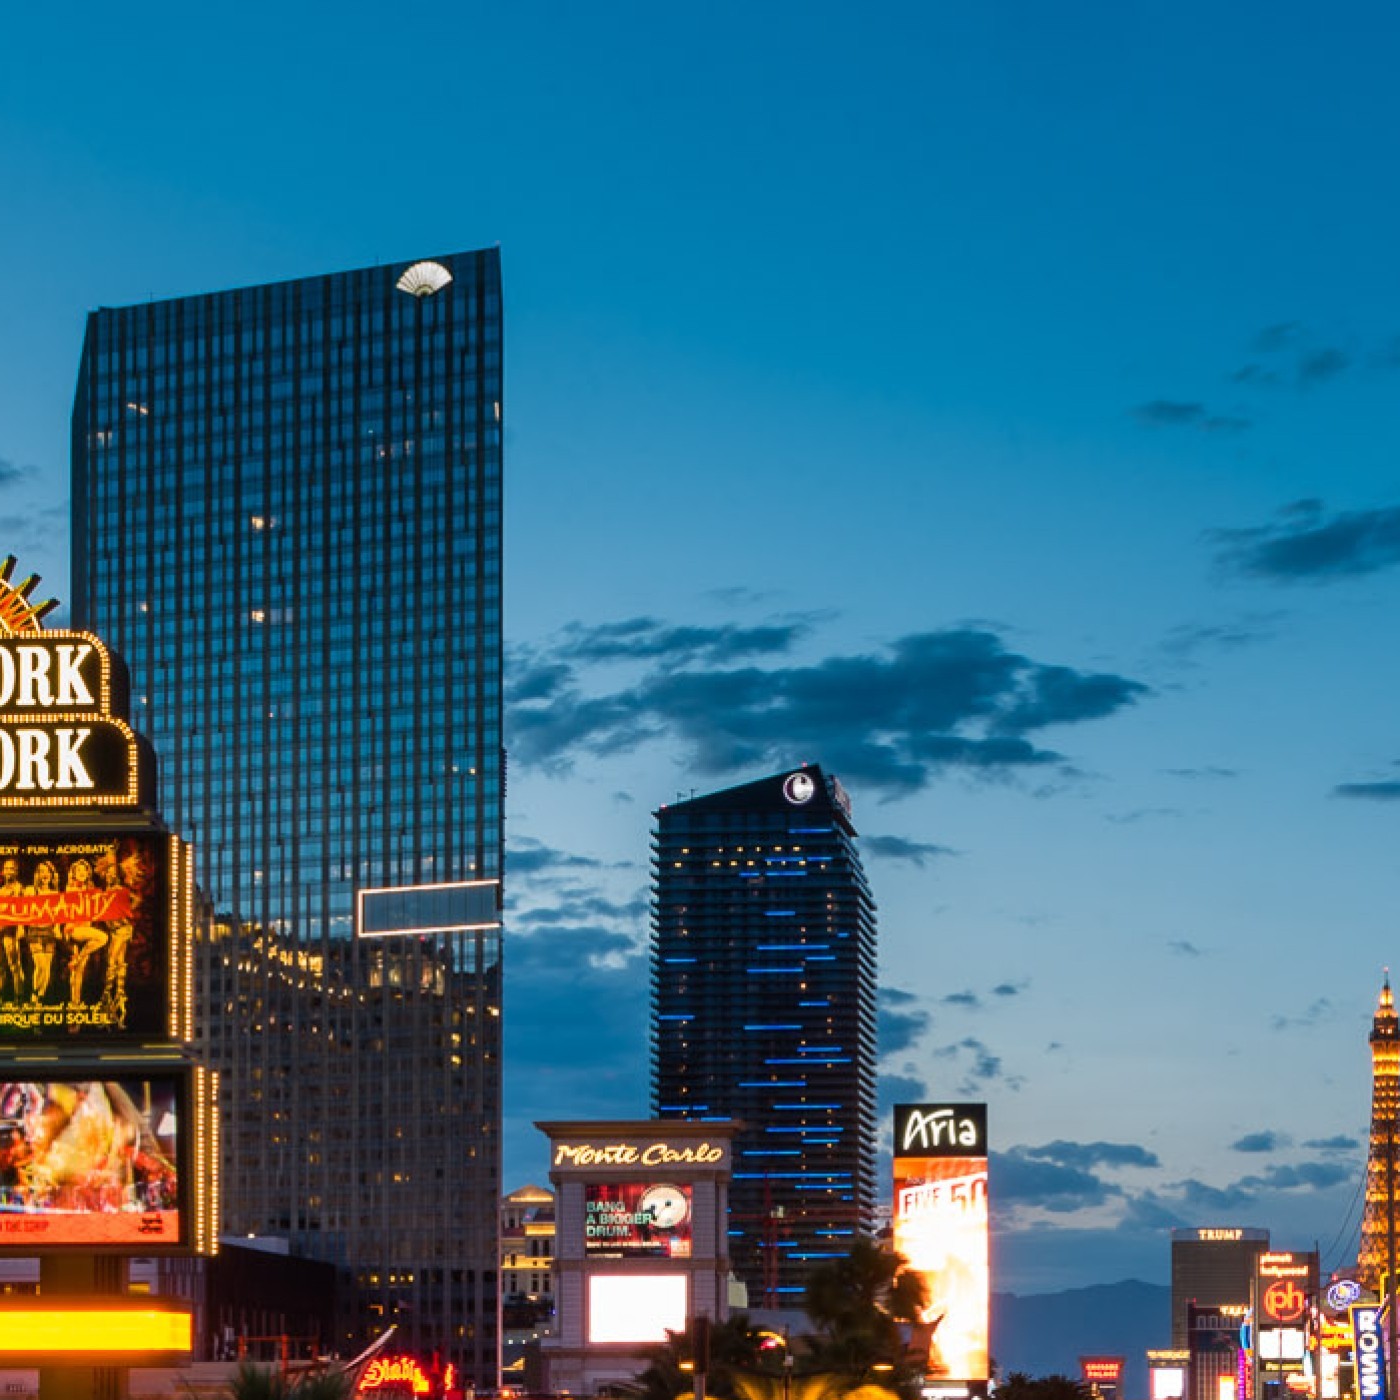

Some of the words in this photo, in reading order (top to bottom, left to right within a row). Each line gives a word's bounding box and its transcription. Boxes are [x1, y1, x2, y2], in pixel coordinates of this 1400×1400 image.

[28, 845, 49, 855] FUN
[44, 1013, 63, 1025] DU
[67, 1013, 112, 1025] SOLEIL
[903, 1109, 976, 1150] Aria
[554, 1144, 640, 1166] Monte
[642, 1143, 723, 1166] Carlo
[587, 1201, 626, 1213] BANG
[587, 1213, 596, 1225] A
[600, 1213, 652, 1225] BIGGER
[1198, 1229, 1243, 1241] TRUMP
[1270, 1282, 1304, 1316] ph
[1357, 1311, 1379, 1396] ROSS
